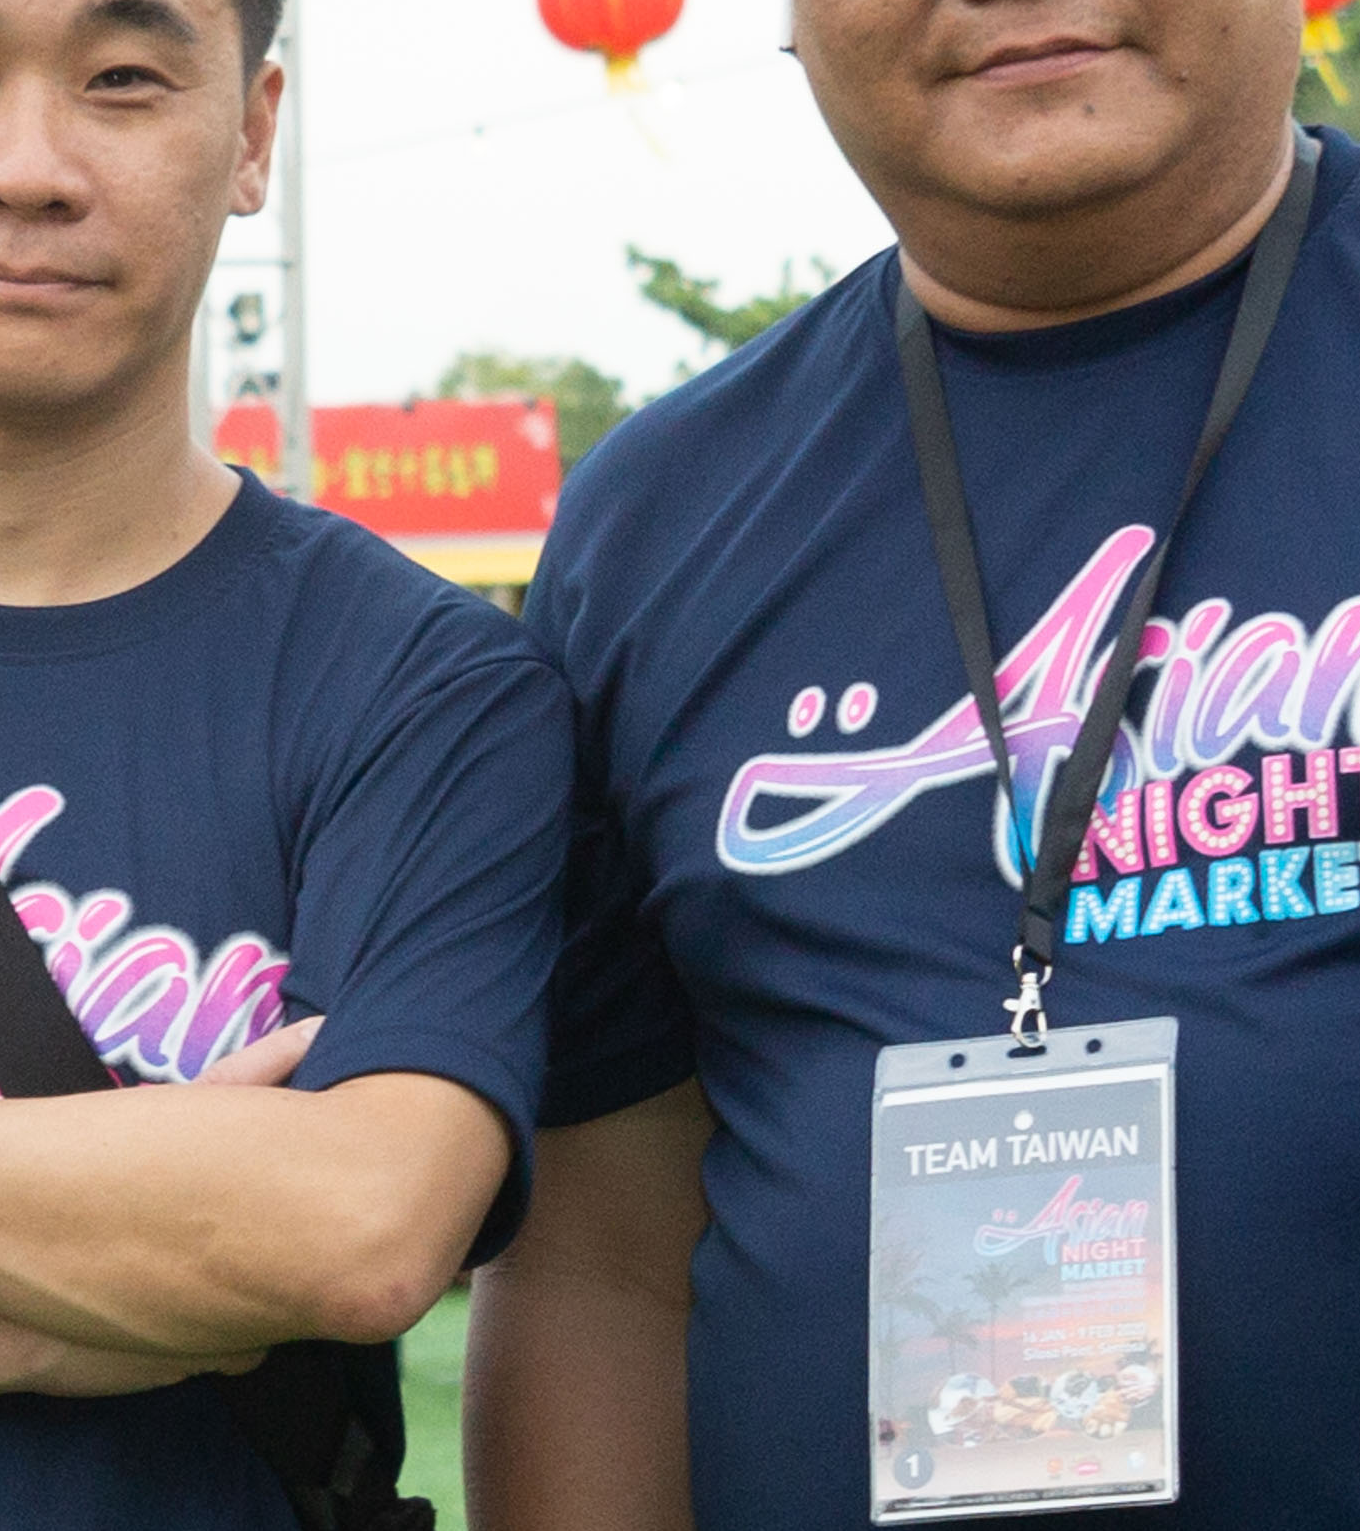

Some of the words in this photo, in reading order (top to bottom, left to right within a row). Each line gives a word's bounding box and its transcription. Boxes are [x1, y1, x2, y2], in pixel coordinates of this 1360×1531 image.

[903, 1137, 998, 1176] TEAM
[1005, 1125, 1139, 1166] TAIWAN
[972, 1174, 1149, 1266] Asian
[1061, 1238, 1147, 1263] NIGHT
[1060, 1257, 1147, 1281] MARKET
[905, 1452, 919, 1478] 1
